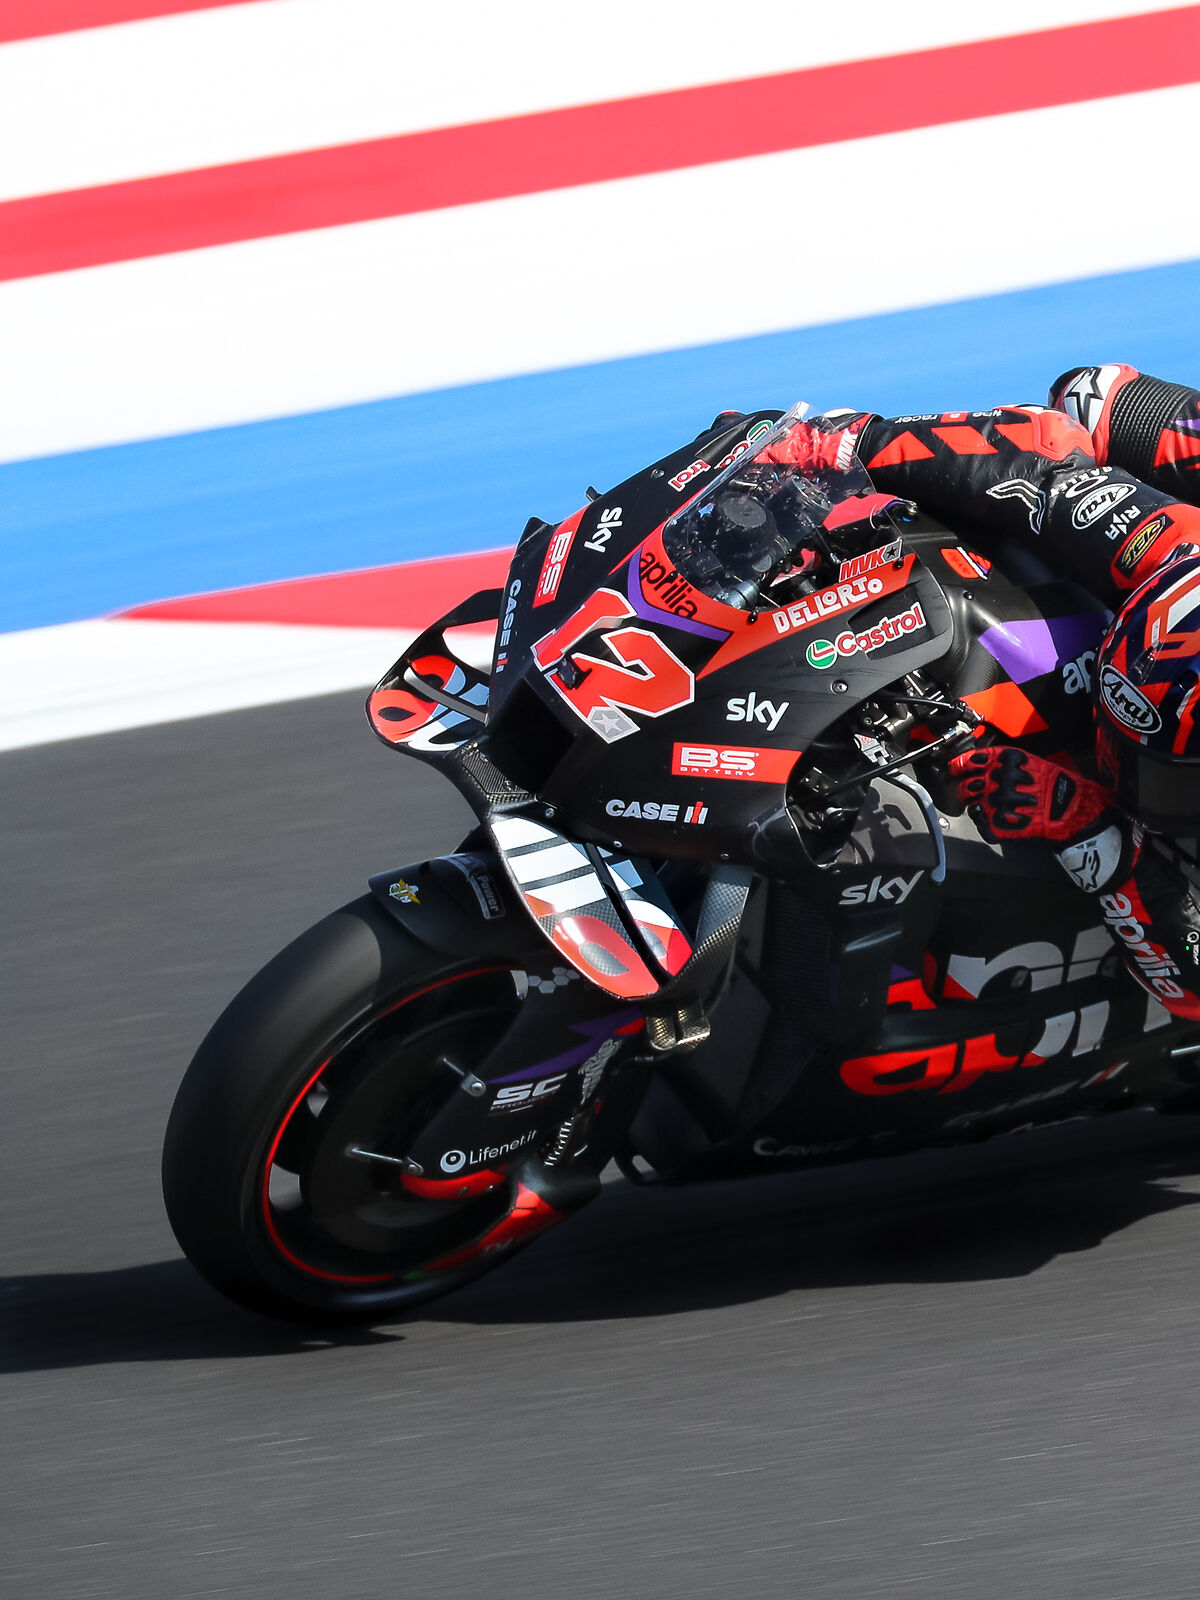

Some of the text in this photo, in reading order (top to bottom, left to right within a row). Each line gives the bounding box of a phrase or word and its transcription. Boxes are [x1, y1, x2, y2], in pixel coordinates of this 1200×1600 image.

[668, 440, 752, 492] Catrol
[1049, 466, 1113, 498] OAKLEY
[1080, 485, 1133, 524] Arai
[584, 506, 623, 553] sky
[543, 531, 573, 595] BS
[839, 546, 886, 583] MVK
[639, 553, 698, 619] aprilia
[500, 579, 521, 647] CASE
[835, 601, 927, 658] Castrol
[530, 587, 695, 745] 12
[726, 691, 790, 732] sky
[1103, 679, 1154, 723] Arai
[680, 747, 760, 770] BS
[605, 799, 680, 822] CASE
[839, 869, 926, 905] sky
[1100, 892, 1185, 998] aprilia
[492, 1073, 568, 1106] SC
[469, 1129, 538, 1165] Lifenet.it
